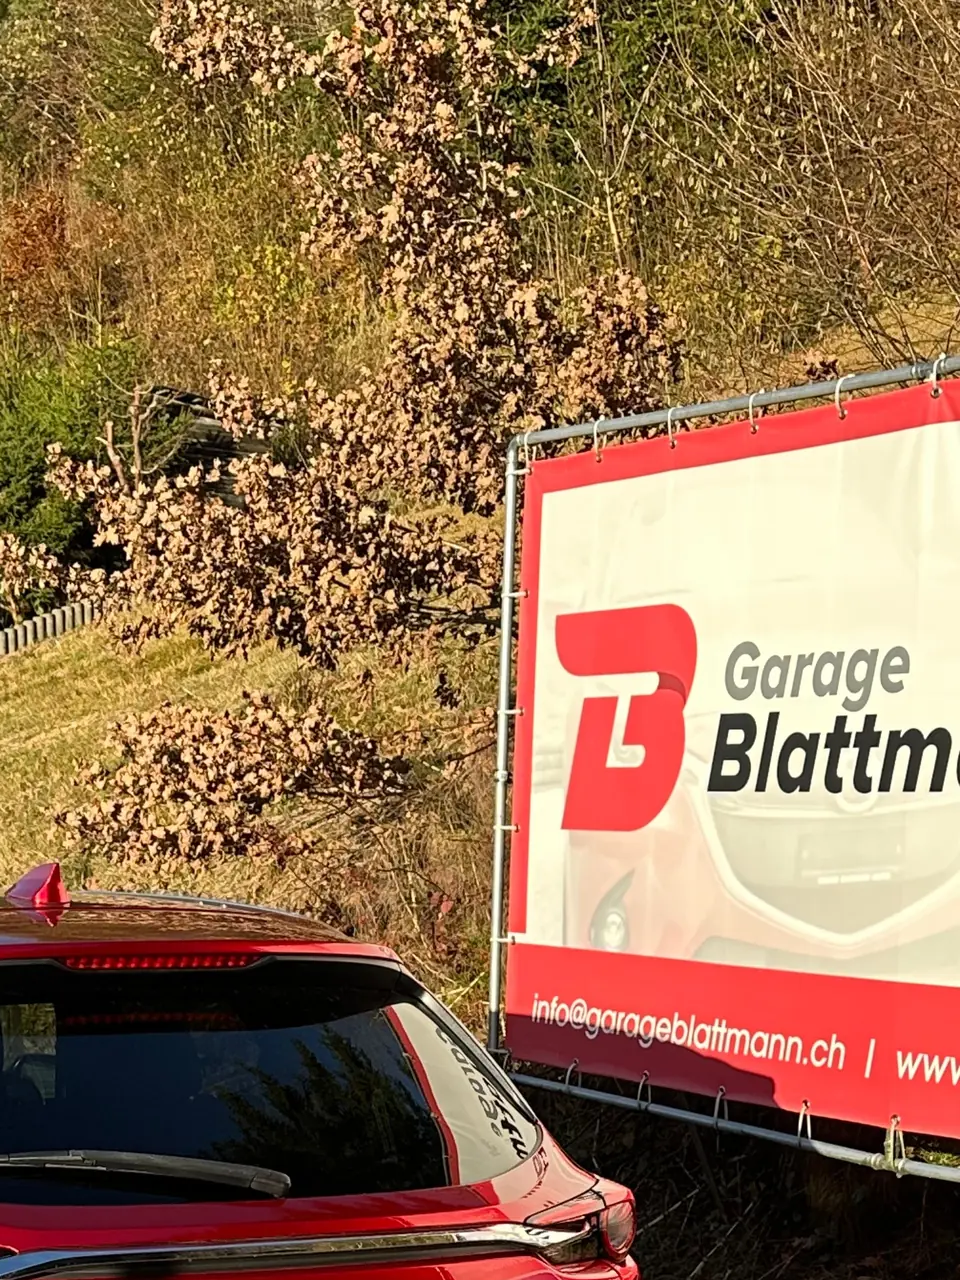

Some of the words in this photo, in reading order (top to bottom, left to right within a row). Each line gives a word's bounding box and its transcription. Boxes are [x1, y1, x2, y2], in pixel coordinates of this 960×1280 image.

[724, 640, 911, 712] Garage
[707, 711, 960, 794] Blattm
[531, 992, 846, 1071] info@garageblattmann.ch
